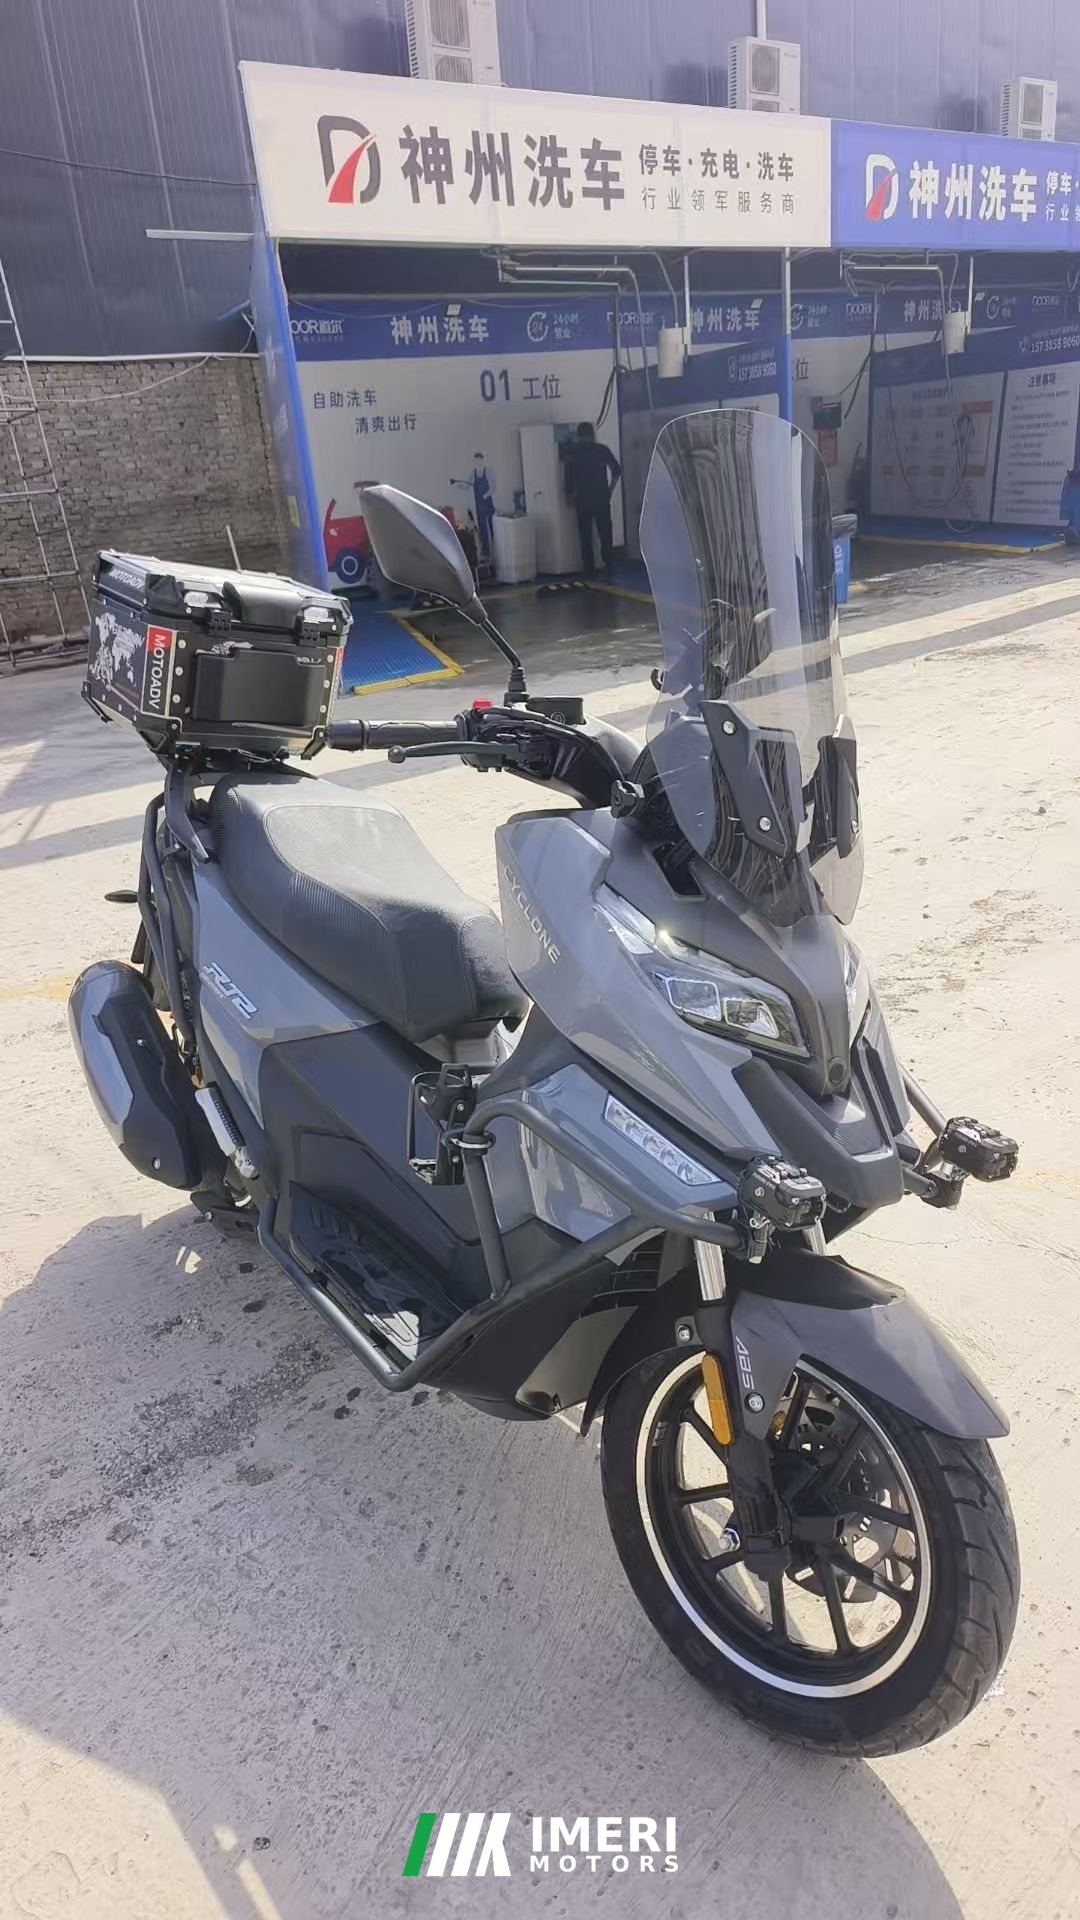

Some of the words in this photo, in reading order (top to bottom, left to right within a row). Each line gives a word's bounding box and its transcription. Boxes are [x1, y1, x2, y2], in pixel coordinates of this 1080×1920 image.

[399, 125, 624, 211] 神州洗车
[641, 186, 795, 214] 行业领军服务商
[908, 160, 1038, 222] 神州洗车
[1045, 203, 1080, 222] 行业
[904, 299, 944, 322] 神州洗
[390, 315, 489, 345] 神州洗车
[313, 389, 377, 409] 自助洗车
[480, 368, 511, 401] 01
[522, 373, 561, 401] 工位
[355, 413, 417, 435] 清爽出行
[148, 634, 167, 709] MOTOADV
[504, 865, 561, 964] CYCLONE
[735, 1335, 755, 1390] ABS
